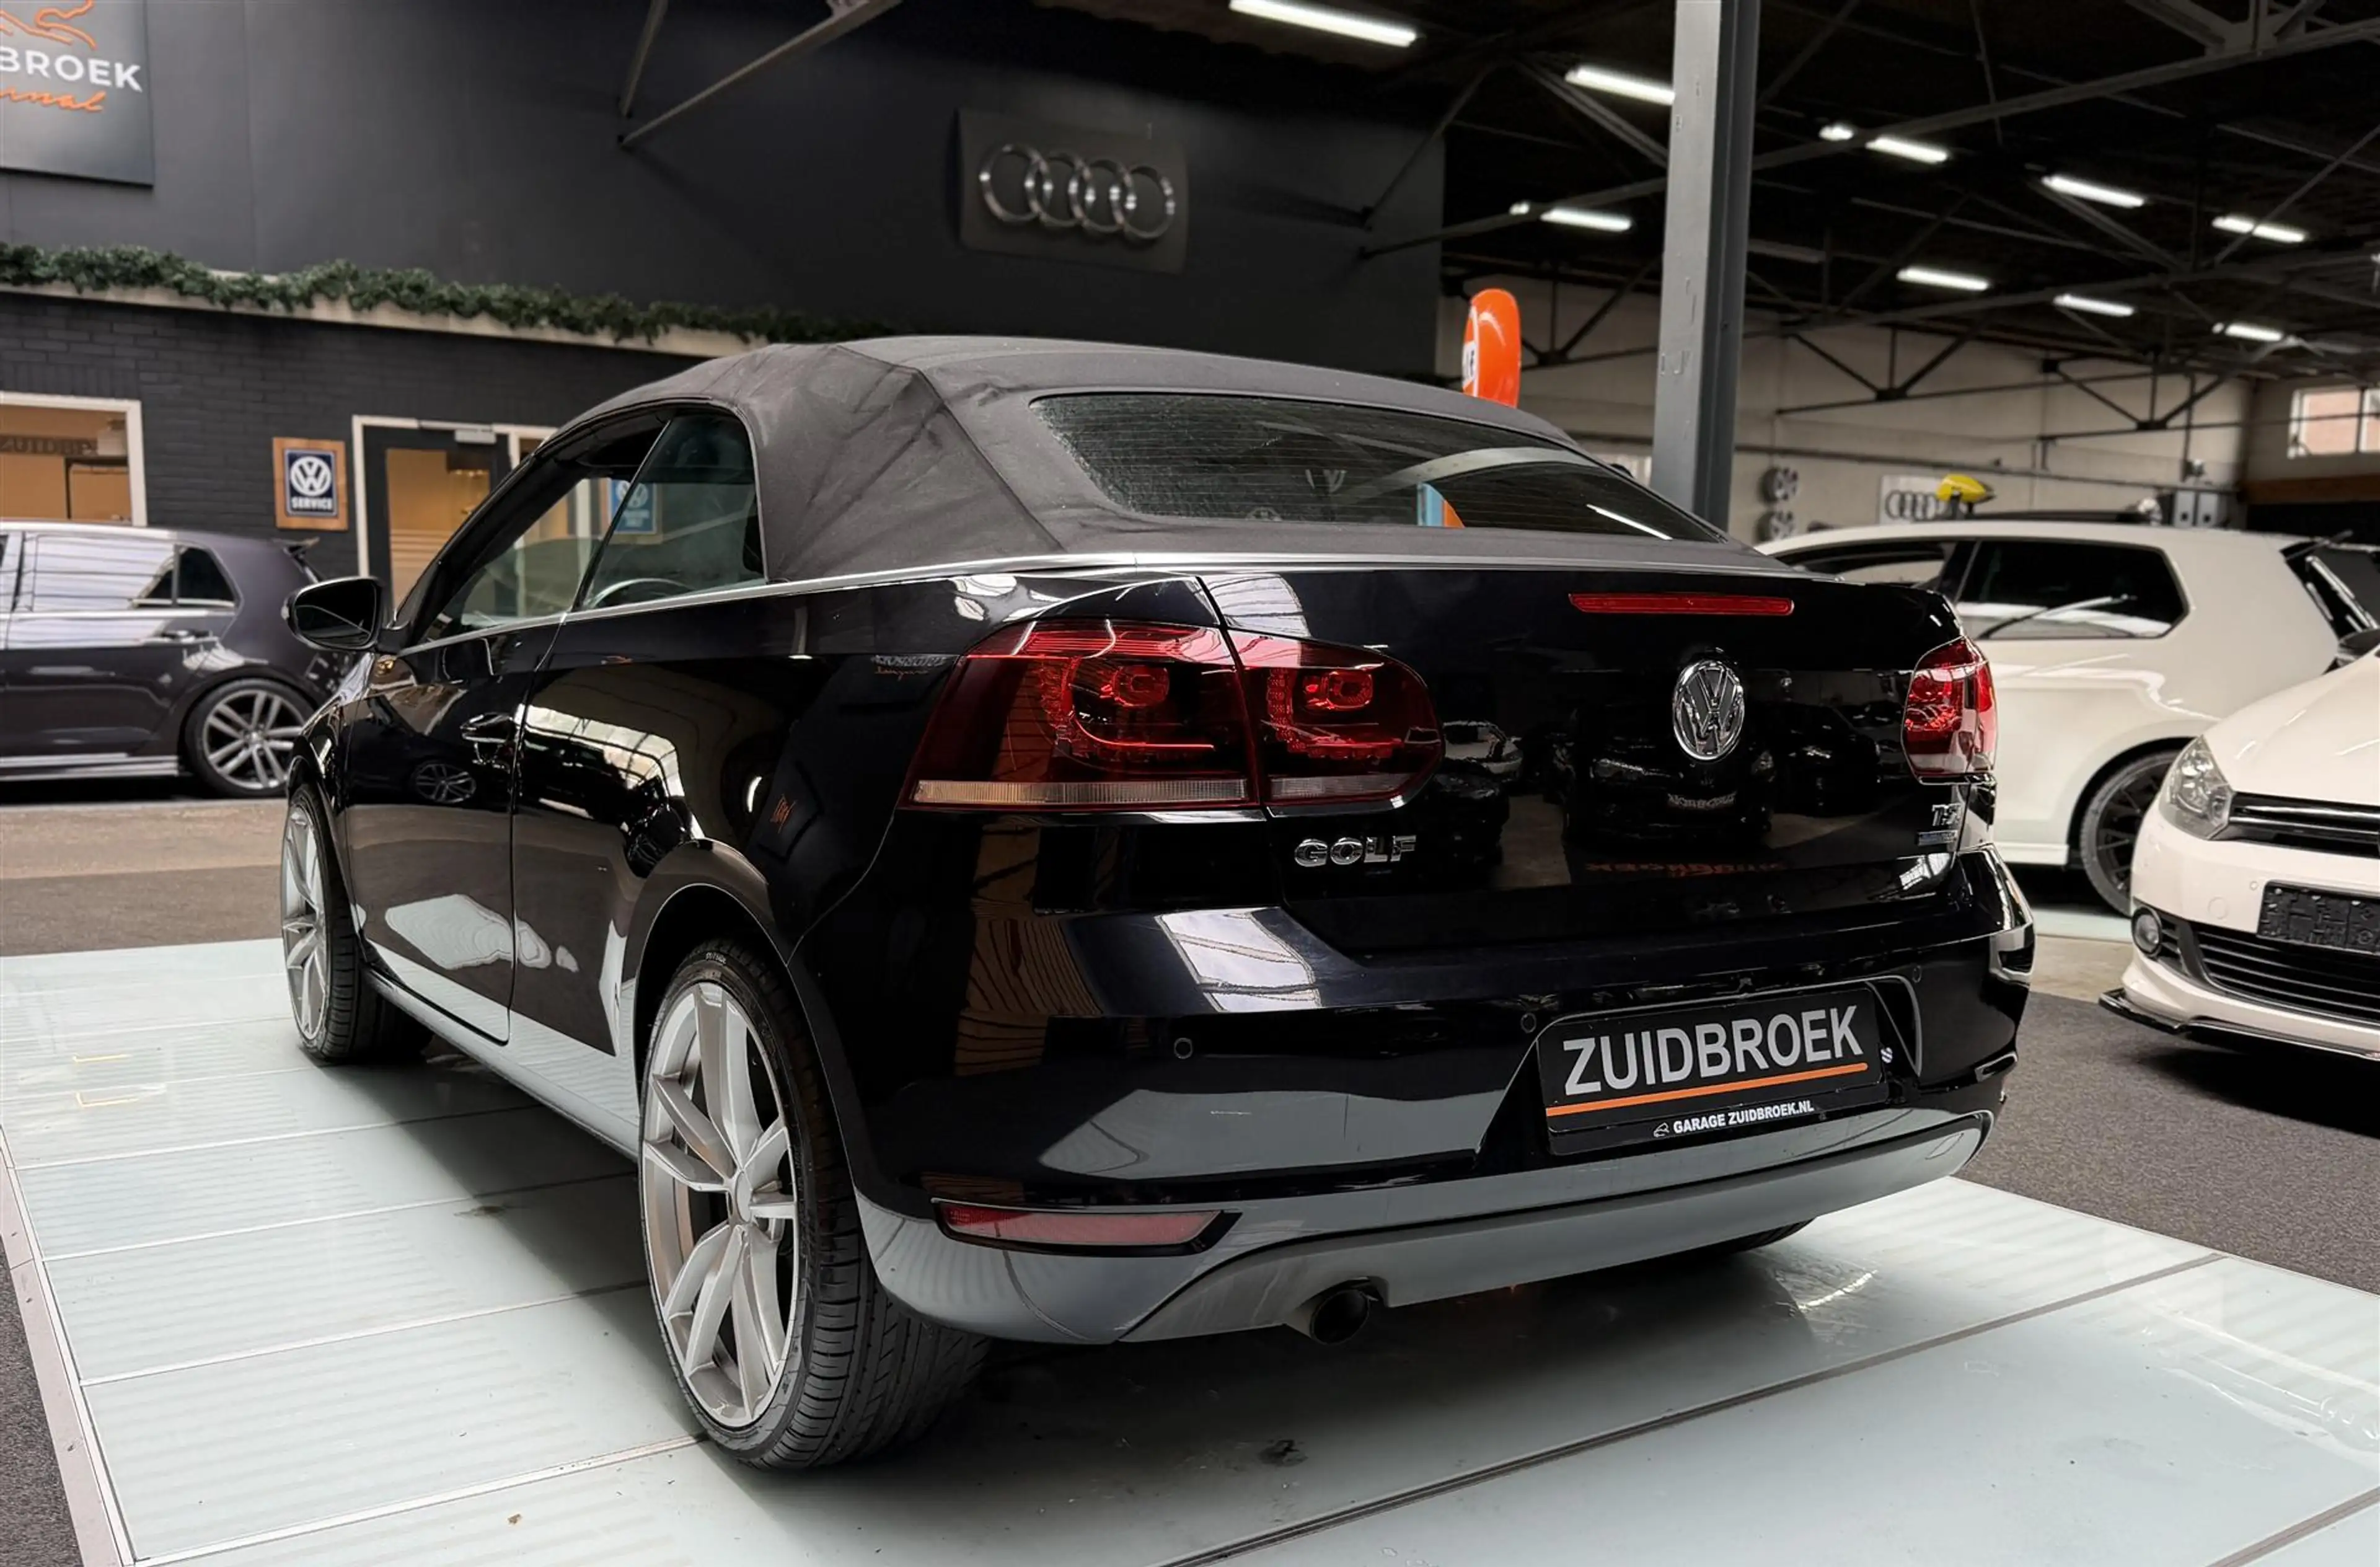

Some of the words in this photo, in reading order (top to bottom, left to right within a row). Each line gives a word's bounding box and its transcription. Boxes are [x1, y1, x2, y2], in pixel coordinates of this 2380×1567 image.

[291, 496, 333, 510] SERVICE
[1294, 835, 1416, 867] GOLF
[1562, 1005, 1863, 1096] ZUIDBROEK
[1673, 1113, 1726, 1134] GARAGE
[1728, 1100, 1815, 1125] ZUIDBROEK.NL
